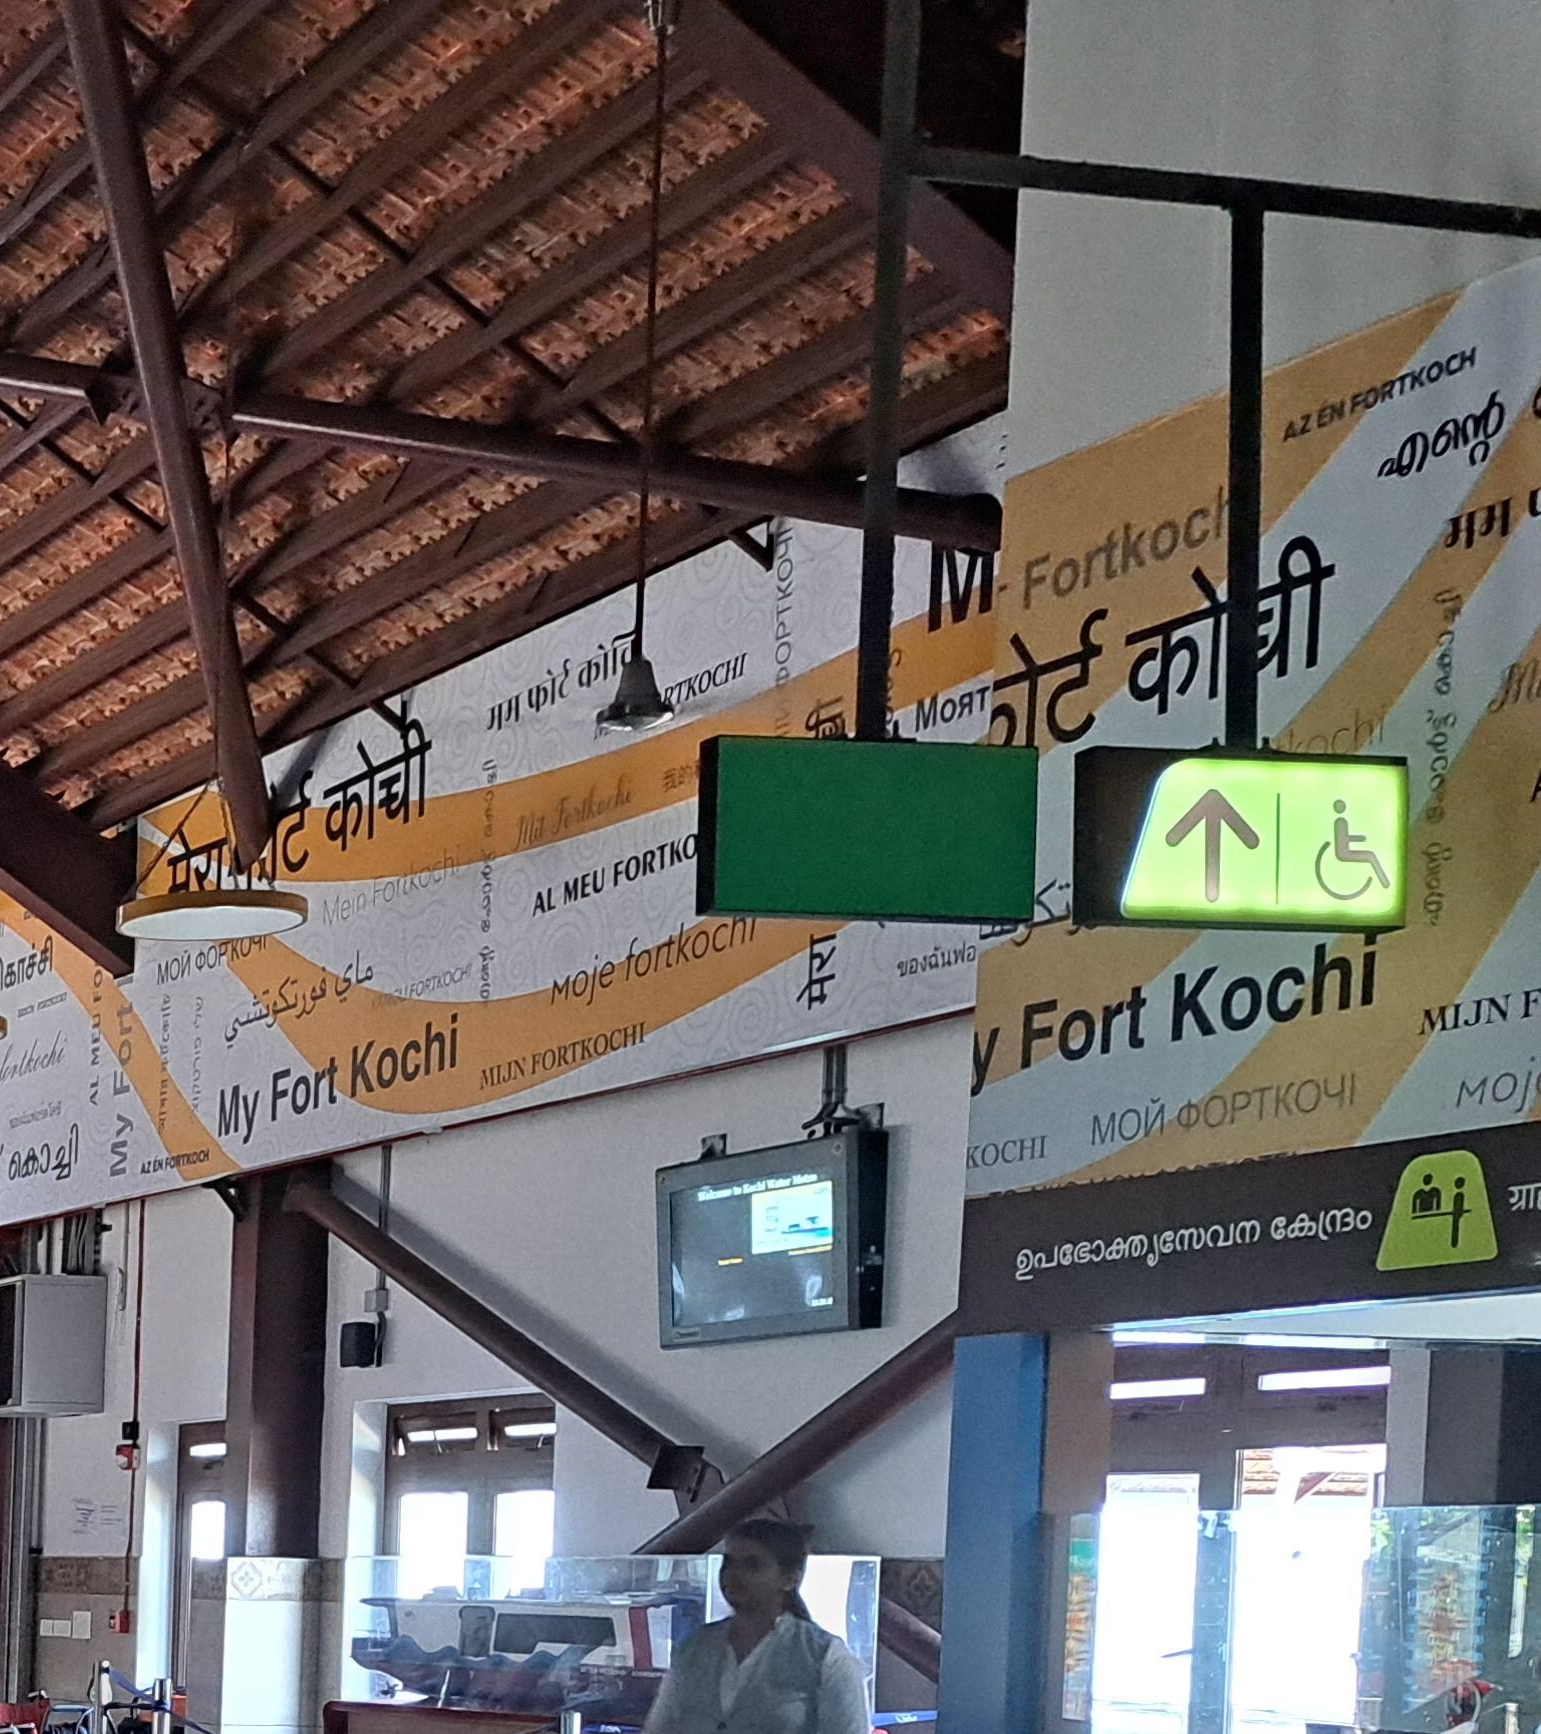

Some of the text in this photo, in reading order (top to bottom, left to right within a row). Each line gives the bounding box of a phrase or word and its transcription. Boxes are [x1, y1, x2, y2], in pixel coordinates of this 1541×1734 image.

[1282, 416, 1312, 443] AZ
[1349, 346, 1477, 416] FORTKOCH
[1377, 389, 1506, 479] എന്റെ
[321, 885, 369, 928] Mein
[532, 891, 559, 918] AL
[563, 871, 607, 908] MEU
[156, 951, 192, 986] МОЙ
[624, 914, 758, 993] fortkochi
[797, 934, 839, 1010] मेरा
[1020, 934, 1379, 1070] Fort Kochi
[1417, 993, 1512, 1036] MIJN
[89, 1015, 103, 1067] MEU
[218, 1011, 459, 1145] My Fort Kochi
[479, 1021, 646, 1091] MIJN FORTKOCHI
[108, 1001, 135, 1178] My Fort
[1091, 1071, 1357, 1147] МОЙ ФОРТКОЧІ
[140, 1159, 153, 1175] AZ
